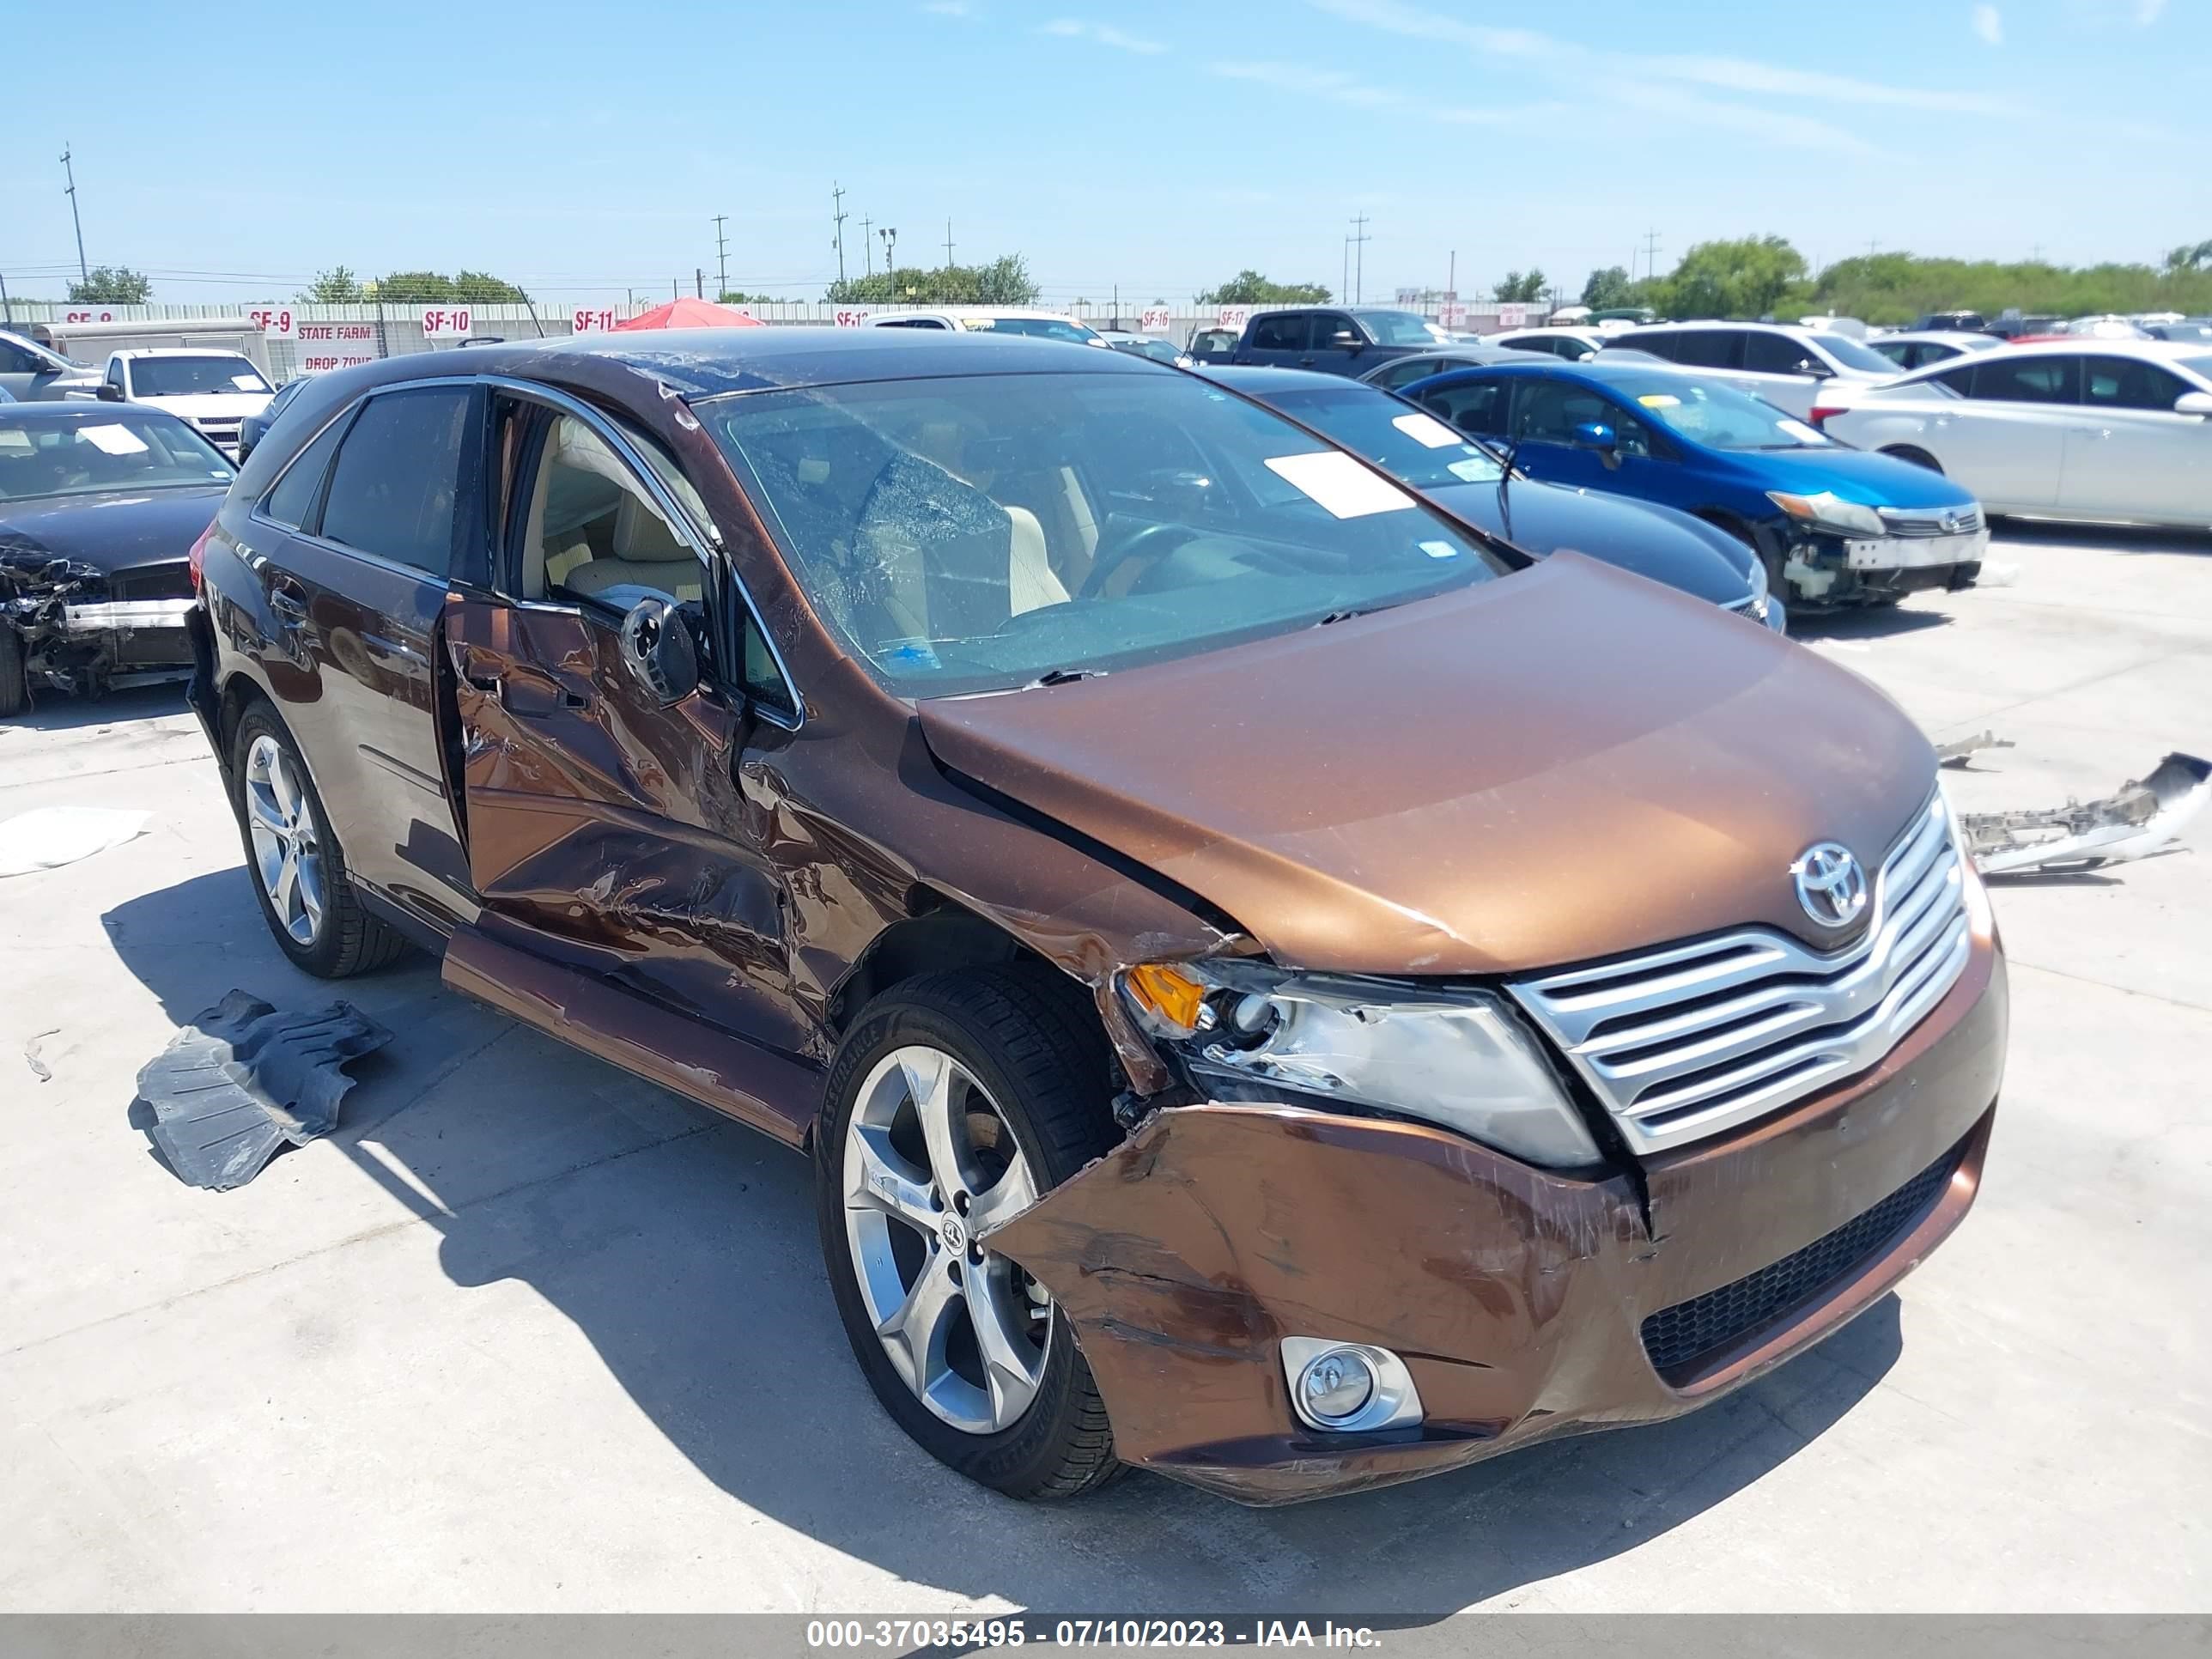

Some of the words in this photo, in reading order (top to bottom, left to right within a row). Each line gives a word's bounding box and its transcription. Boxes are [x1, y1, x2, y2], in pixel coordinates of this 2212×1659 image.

[424, 310, 469, 332] SF-10
[574, 310, 613, 332] SF-11
[1143, 311, 1169, 327] SF-16
[1220, 311, 1244, 326] SF-17
[298, 326, 333, 340] STATE
[337, 326, 371, 339] FARM
[305, 356, 339, 370] DROP
